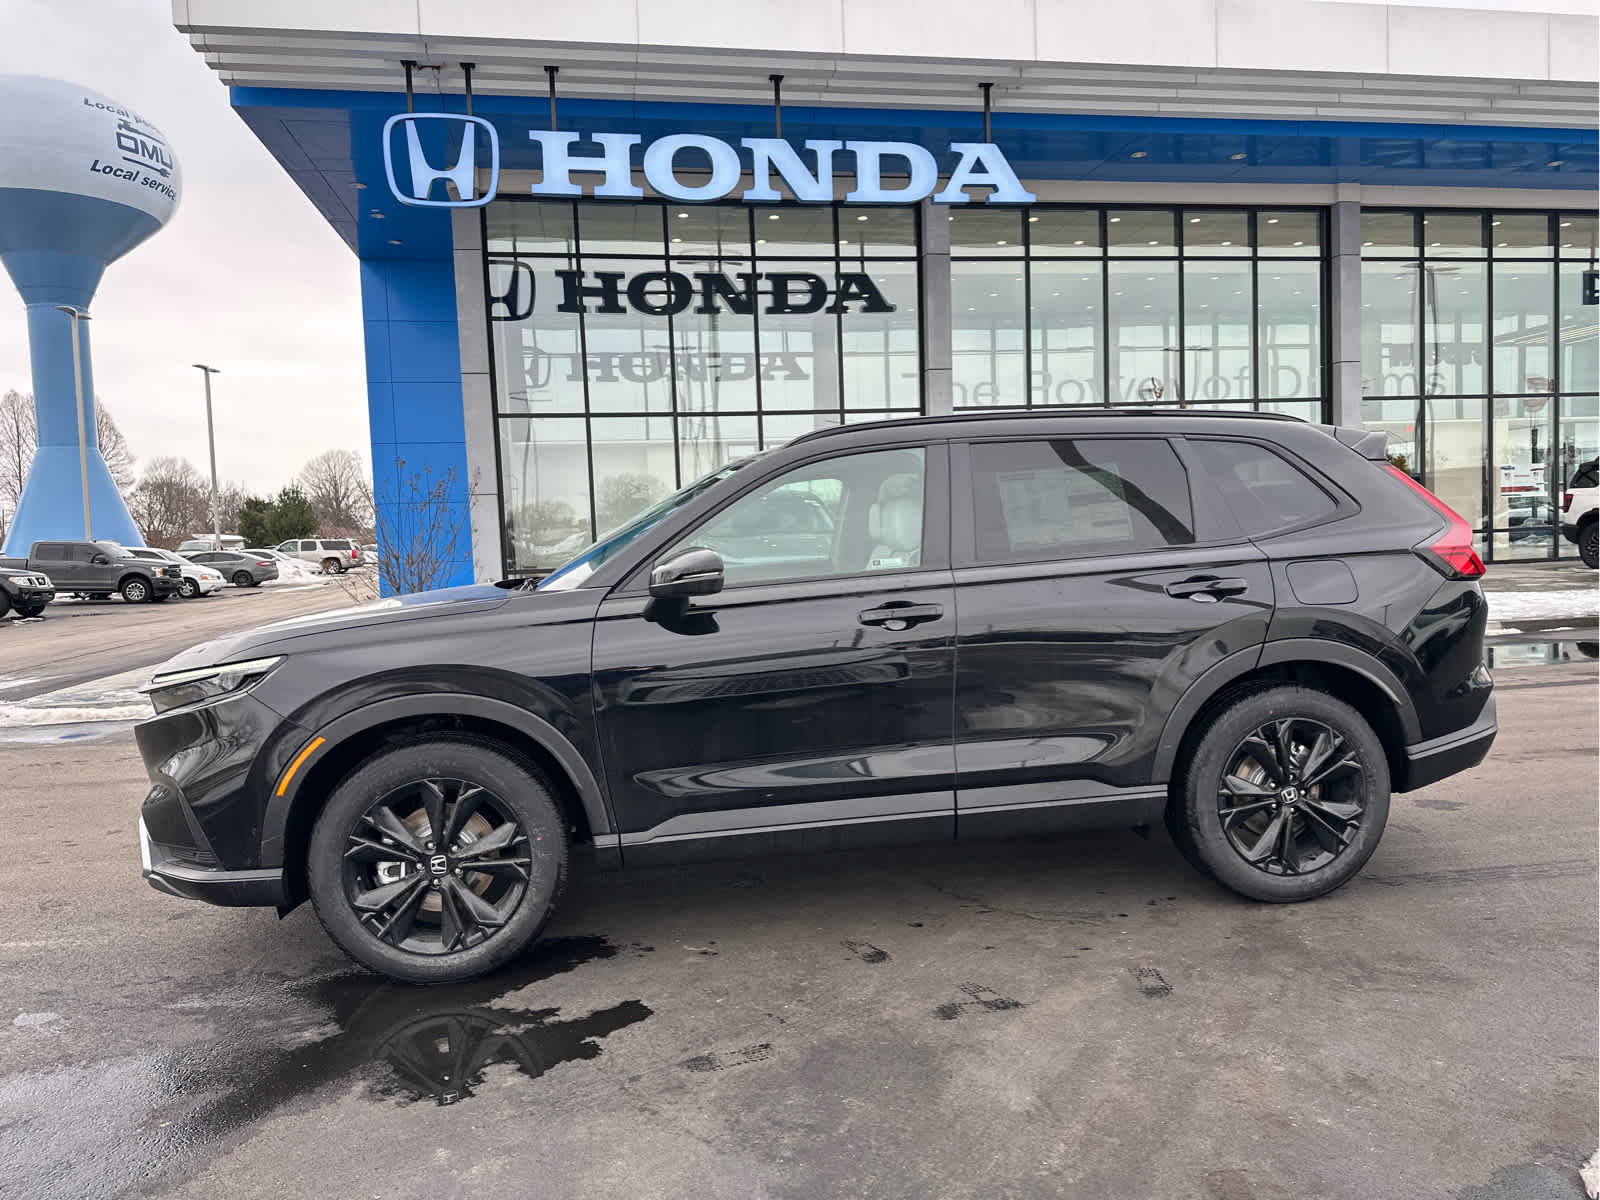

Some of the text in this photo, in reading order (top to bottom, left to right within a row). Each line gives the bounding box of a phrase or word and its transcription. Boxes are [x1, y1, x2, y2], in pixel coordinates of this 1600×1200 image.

[84, 98, 129, 118] Local
[115, 131, 173, 170] OMU
[528, 129, 1037, 206] HONDA
[90, 159, 140, 182] Local
[555, 269, 897, 314] HONDA
